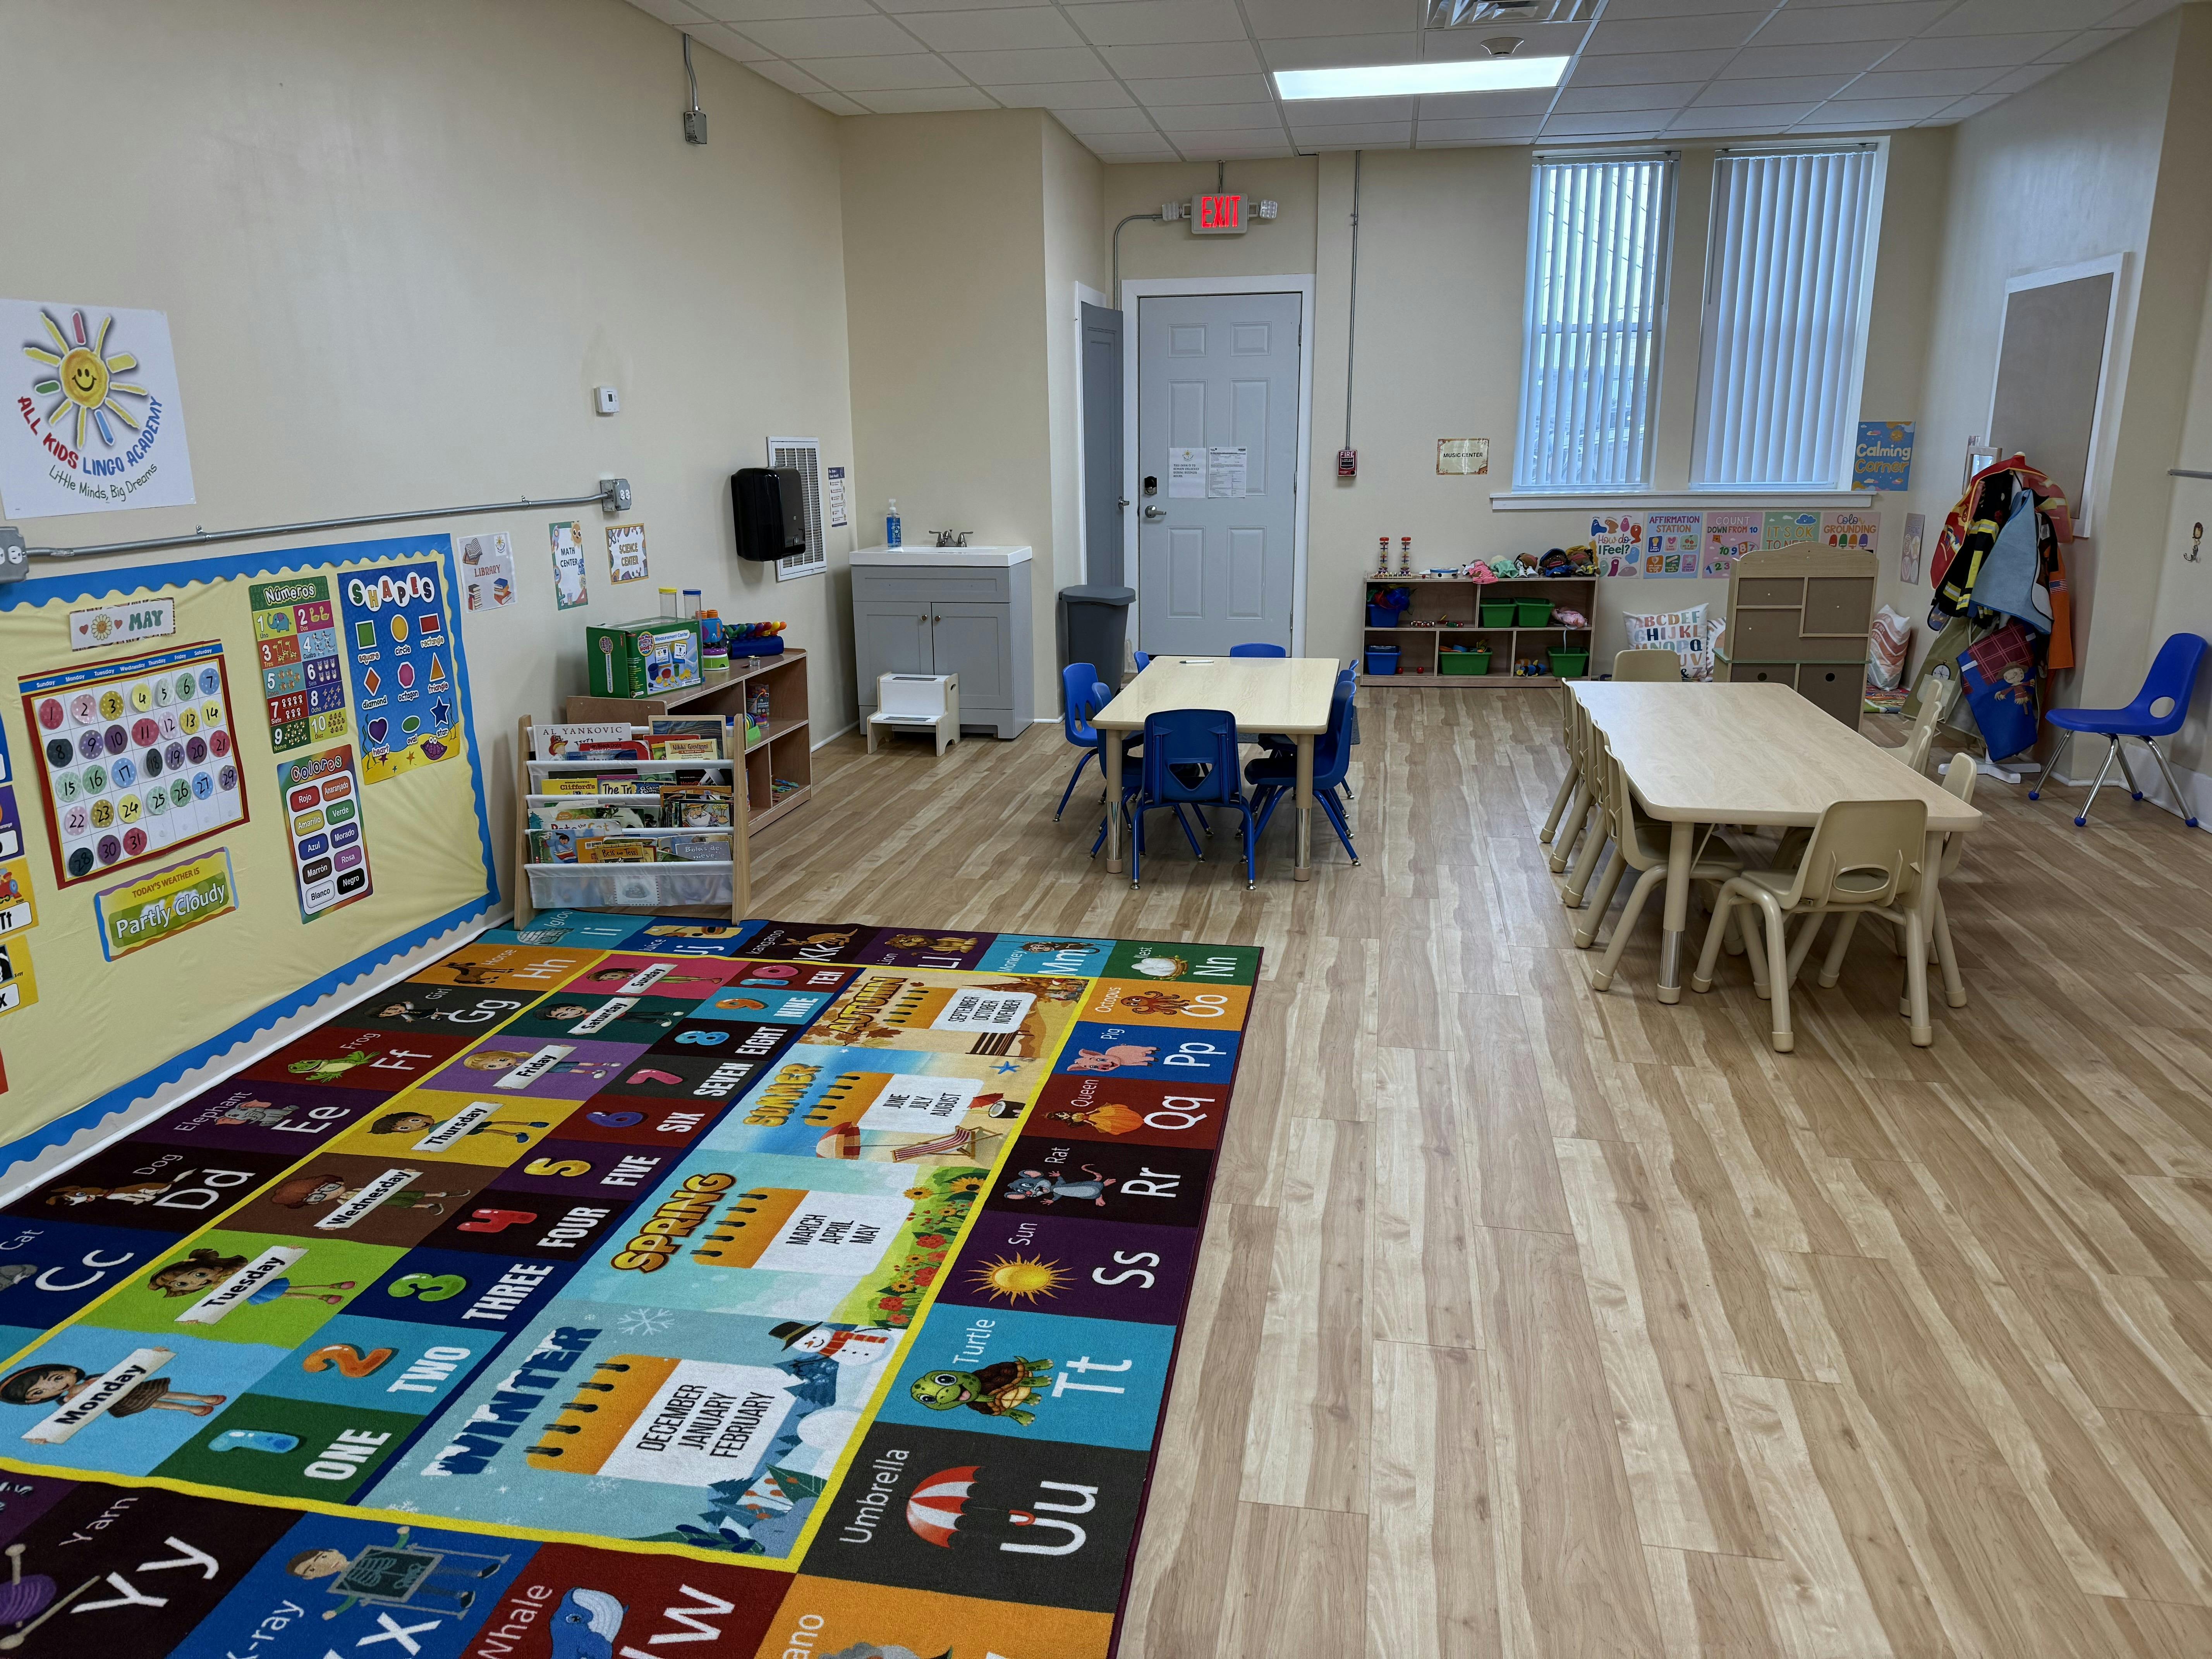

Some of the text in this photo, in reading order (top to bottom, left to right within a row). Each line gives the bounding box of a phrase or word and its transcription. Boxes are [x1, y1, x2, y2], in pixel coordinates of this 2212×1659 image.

[1202, 196, 1241, 228] EXIT
[17, 396, 163, 476] ALL KIDS LINGO ACADEMY
[1856, 441, 1911, 460] Calming
[1855, 460, 1909, 473] Corner
[49, 463, 158, 501] Little Minds, Big Dreams
[1649, 516, 1700, 524] AFFIRMATION
[1656, 525, 1691, 533] STATION
[1716, 517, 1750, 525] COUNT
[1824, 525, 1876, 533] GROUNDING
[1837, 514, 1865, 525] Color
[1598, 534, 1631, 544] How do
[1767, 526, 1814, 538] IT'S OK
[561, 547, 575, 556] MATH
[619, 543, 638, 554] SCIENCE
[1599, 544, 1630, 555] I Feel?
[1767, 540, 1781, 550] TO
[474, 565, 500, 577] LIBRARY
[560, 559, 578, 567] CENTER
[622, 556, 638, 567] CENTER
[265, 584, 314, 604] Números
[352, 577, 431, 608] SHAPES
[129, 610, 163, 631] MAY
[422, 637, 444, 647] rectangle
[120, 663, 145, 671] Wednesday
[148, 658, 165, 666] Thursday
[359, 653, 379, 663] square
[184, 678, 190, 694] 6
[206, 677, 212, 688] 7
[428, 683, 448, 693] triangle
[139, 693, 146, 703] 4
[162, 689, 167, 700] 5
[363, 697, 386, 708] diamond
[398, 691, 418, 701] octagon
[50, 707, 53, 720] 1
[81, 703, 88, 716] 2
[110, 699, 116, 713] 3
[373, 745, 389, 755] heart
[291, 755, 342, 782] Colores
[602, 783, 619, 794] The
[299, 795, 312, 804] Rojo
[333, 807, 349, 817] Verde
[298, 816, 321, 830] Amarillo
[335, 830, 355, 842] Morado
[308, 842, 320, 852] Azul
[342, 854, 355, 864] Rosa
[307, 865, 327, 877] Marrón
[132, 867, 199, 898] TODAY'S WEATHER IS
[343, 875, 359, 888] Negro
[311, 888, 330, 900] Blanco
[116, 883, 225, 939] Partly Cloudy
[482, 949, 517, 965] Horse
[631, 969, 662, 988] Sunday
[806, 971, 845, 985] TEN
[425, 989, 452, 1000] Girl
[1094, 987, 1122, 1013] Octopus
[774, 998, 819, 1018] NINE
[825, 977, 909, 1035] AUTUMN
[947, 996, 980, 1024] SEPTEMBER
[972, 999, 999, 1022] OCTOBER
[992, 998, 1022, 1024] NOVEMBER
[581, 1002, 629, 1030] Saturday
[339, 1033, 381, 1049] Frog
[735, 1027, 788, 1055] EIGHT
[1101, 1028, 1125, 1041] Pig
[516, 1054, 557, 1078] Friday
[693, 1062, 754, 1097] SEVEN
[743, 1063, 825, 1127] SUMMER
[882, 1093, 910, 1110] JUNE
[1071, 1079, 1099, 1107] Queen
[174, 1092, 253, 1132] Elephant
[908, 1096, 934, 1111] JULY
[929, 1092, 962, 1117] AUGUST
[424, 1108, 488, 1146] Thursday
[656, 1112, 705, 1133] SIX
[132, 1154, 183, 1175] Dog
[1044, 1147, 1070, 1164] Rat
[599, 1155, 661, 1187] FIVE
[328, 1170, 411, 1228] Wednesday
[536, 1207, 611, 1248] FOUR
[610, 1172, 737, 1275] SPRING
[785, 1214, 828, 1245] MARCH
[819, 1220, 855, 1244] APRIL
[0, 1229, 44, 1251] Cat
[849, 1224, 881, 1245] MAY
[1008, 1223, 1038, 1246] Sun
[1092, 1250, 1160, 1289] Ss
[202, 1257, 286, 1307] Tuesday
[462, 1263, 554, 1320] THREE
[952, 1318, 995, 1364] Turtle
[388, 1346, 471, 1393] TWO
[1051, 1356, 1132, 1397] Tt
[54, 1364, 146, 1425] Monday
[421, 1326, 602, 1477] WINTER
[636, 1384, 708, 1452] DECEMBER
[677, 1392, 737, 1450] JANUARY
[709, 1391, 775, 1459] FEBRUARY
[304, 1429, 392, 1480] ONE
[840, 1448, 910, 1544] Umbrella
[58, 1497, 139, 1547] Yarn
[1000, 1480, 1098, 1556] Uu
